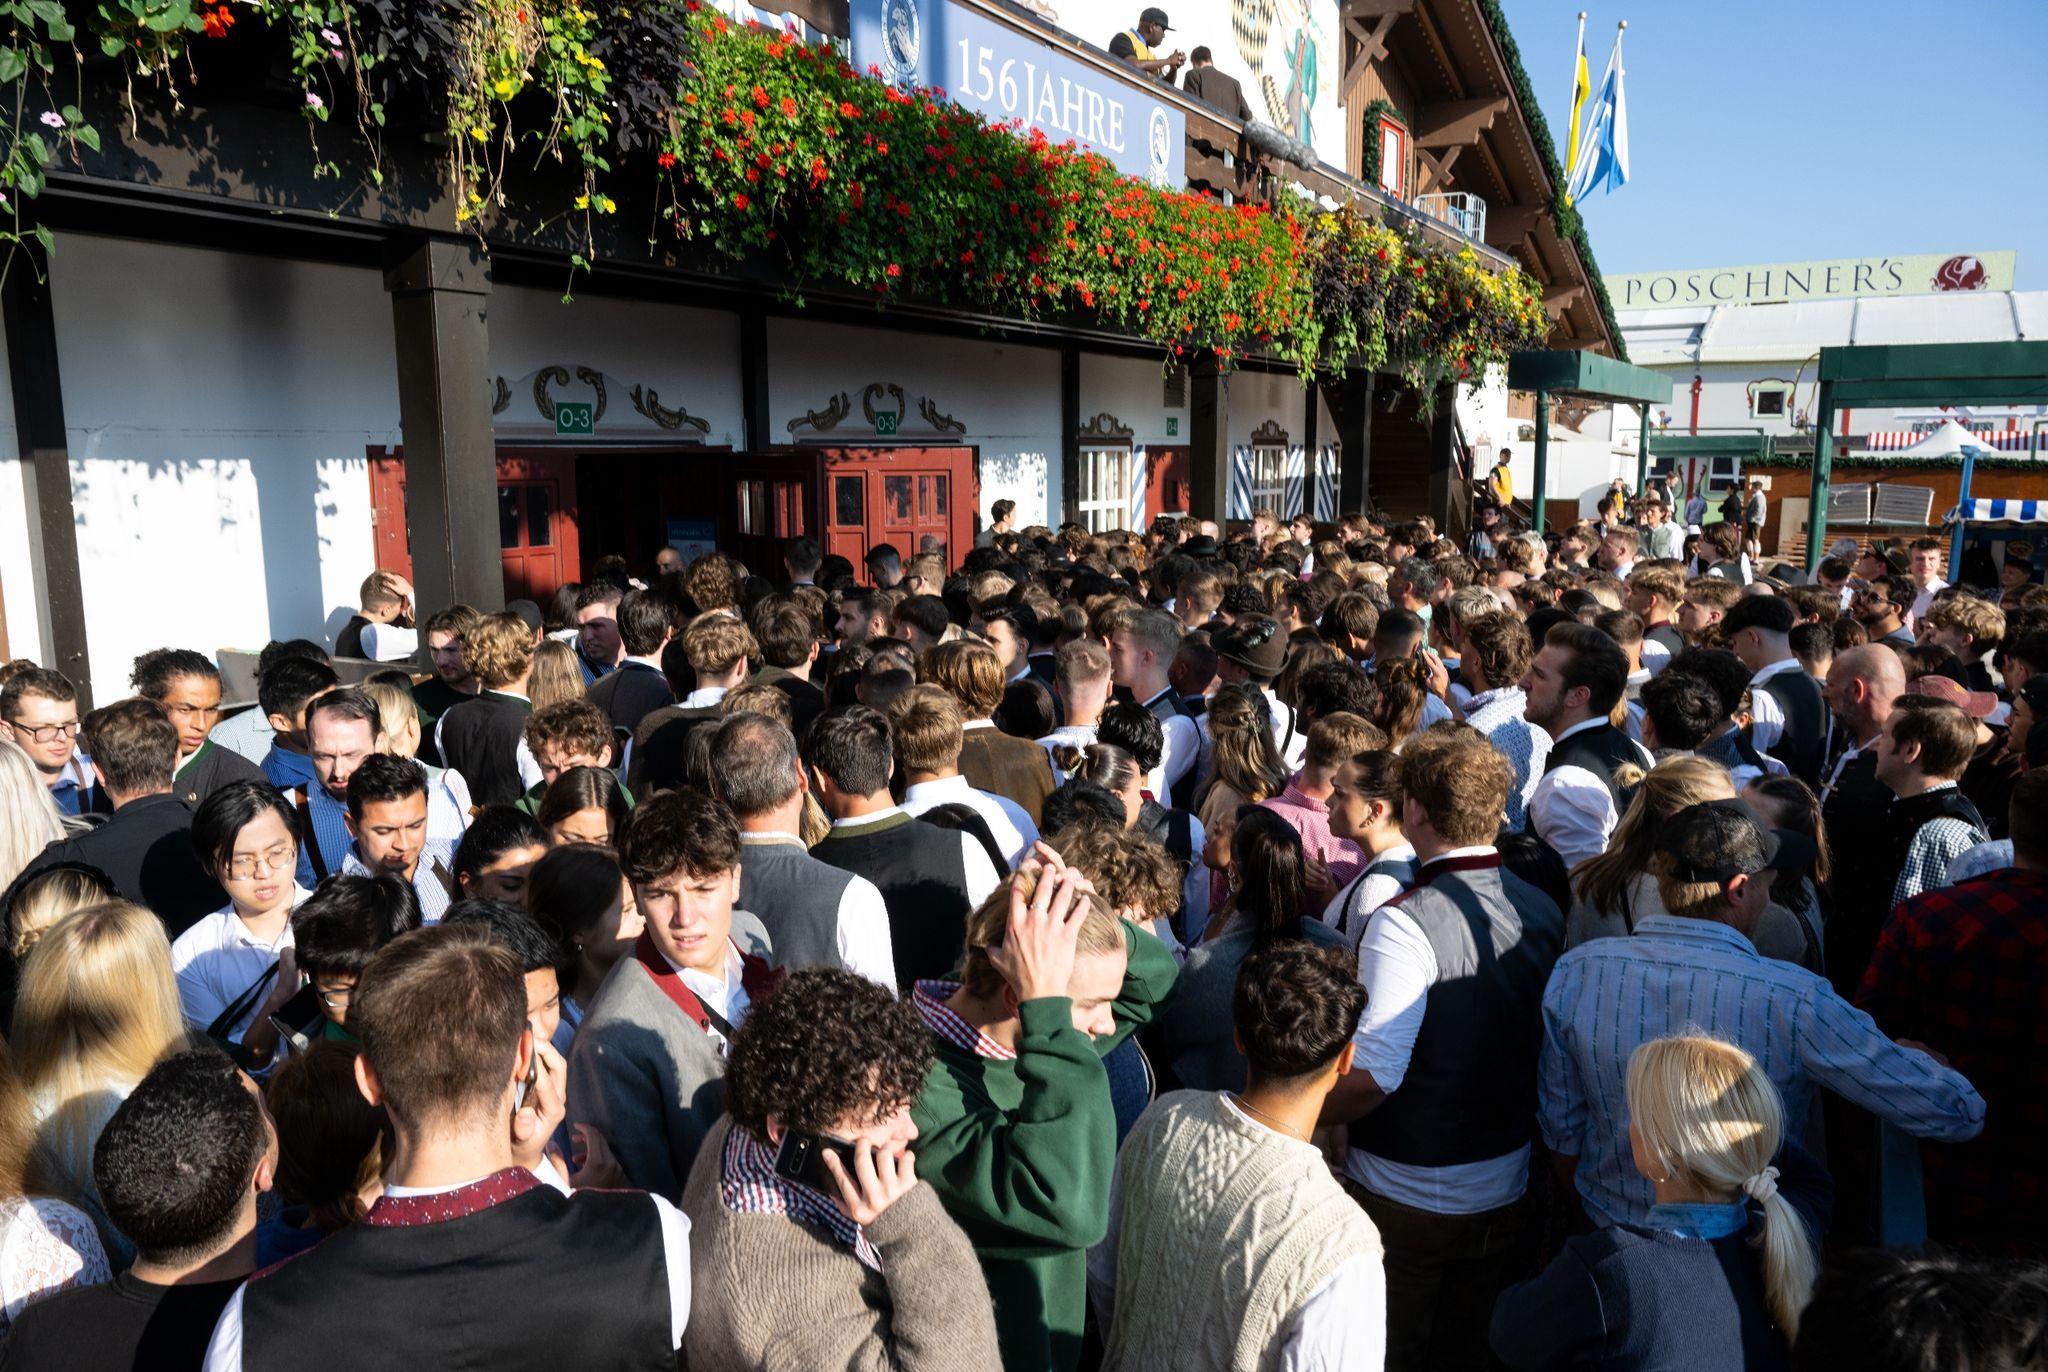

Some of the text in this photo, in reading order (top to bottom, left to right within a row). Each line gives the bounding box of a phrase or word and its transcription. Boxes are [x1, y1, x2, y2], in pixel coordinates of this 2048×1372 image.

[958, 37, 1018, 112] 156
[1022, 60, 1126, 154] JAHRE
[1626, 258, 1903, 305] POSCHNER'S
